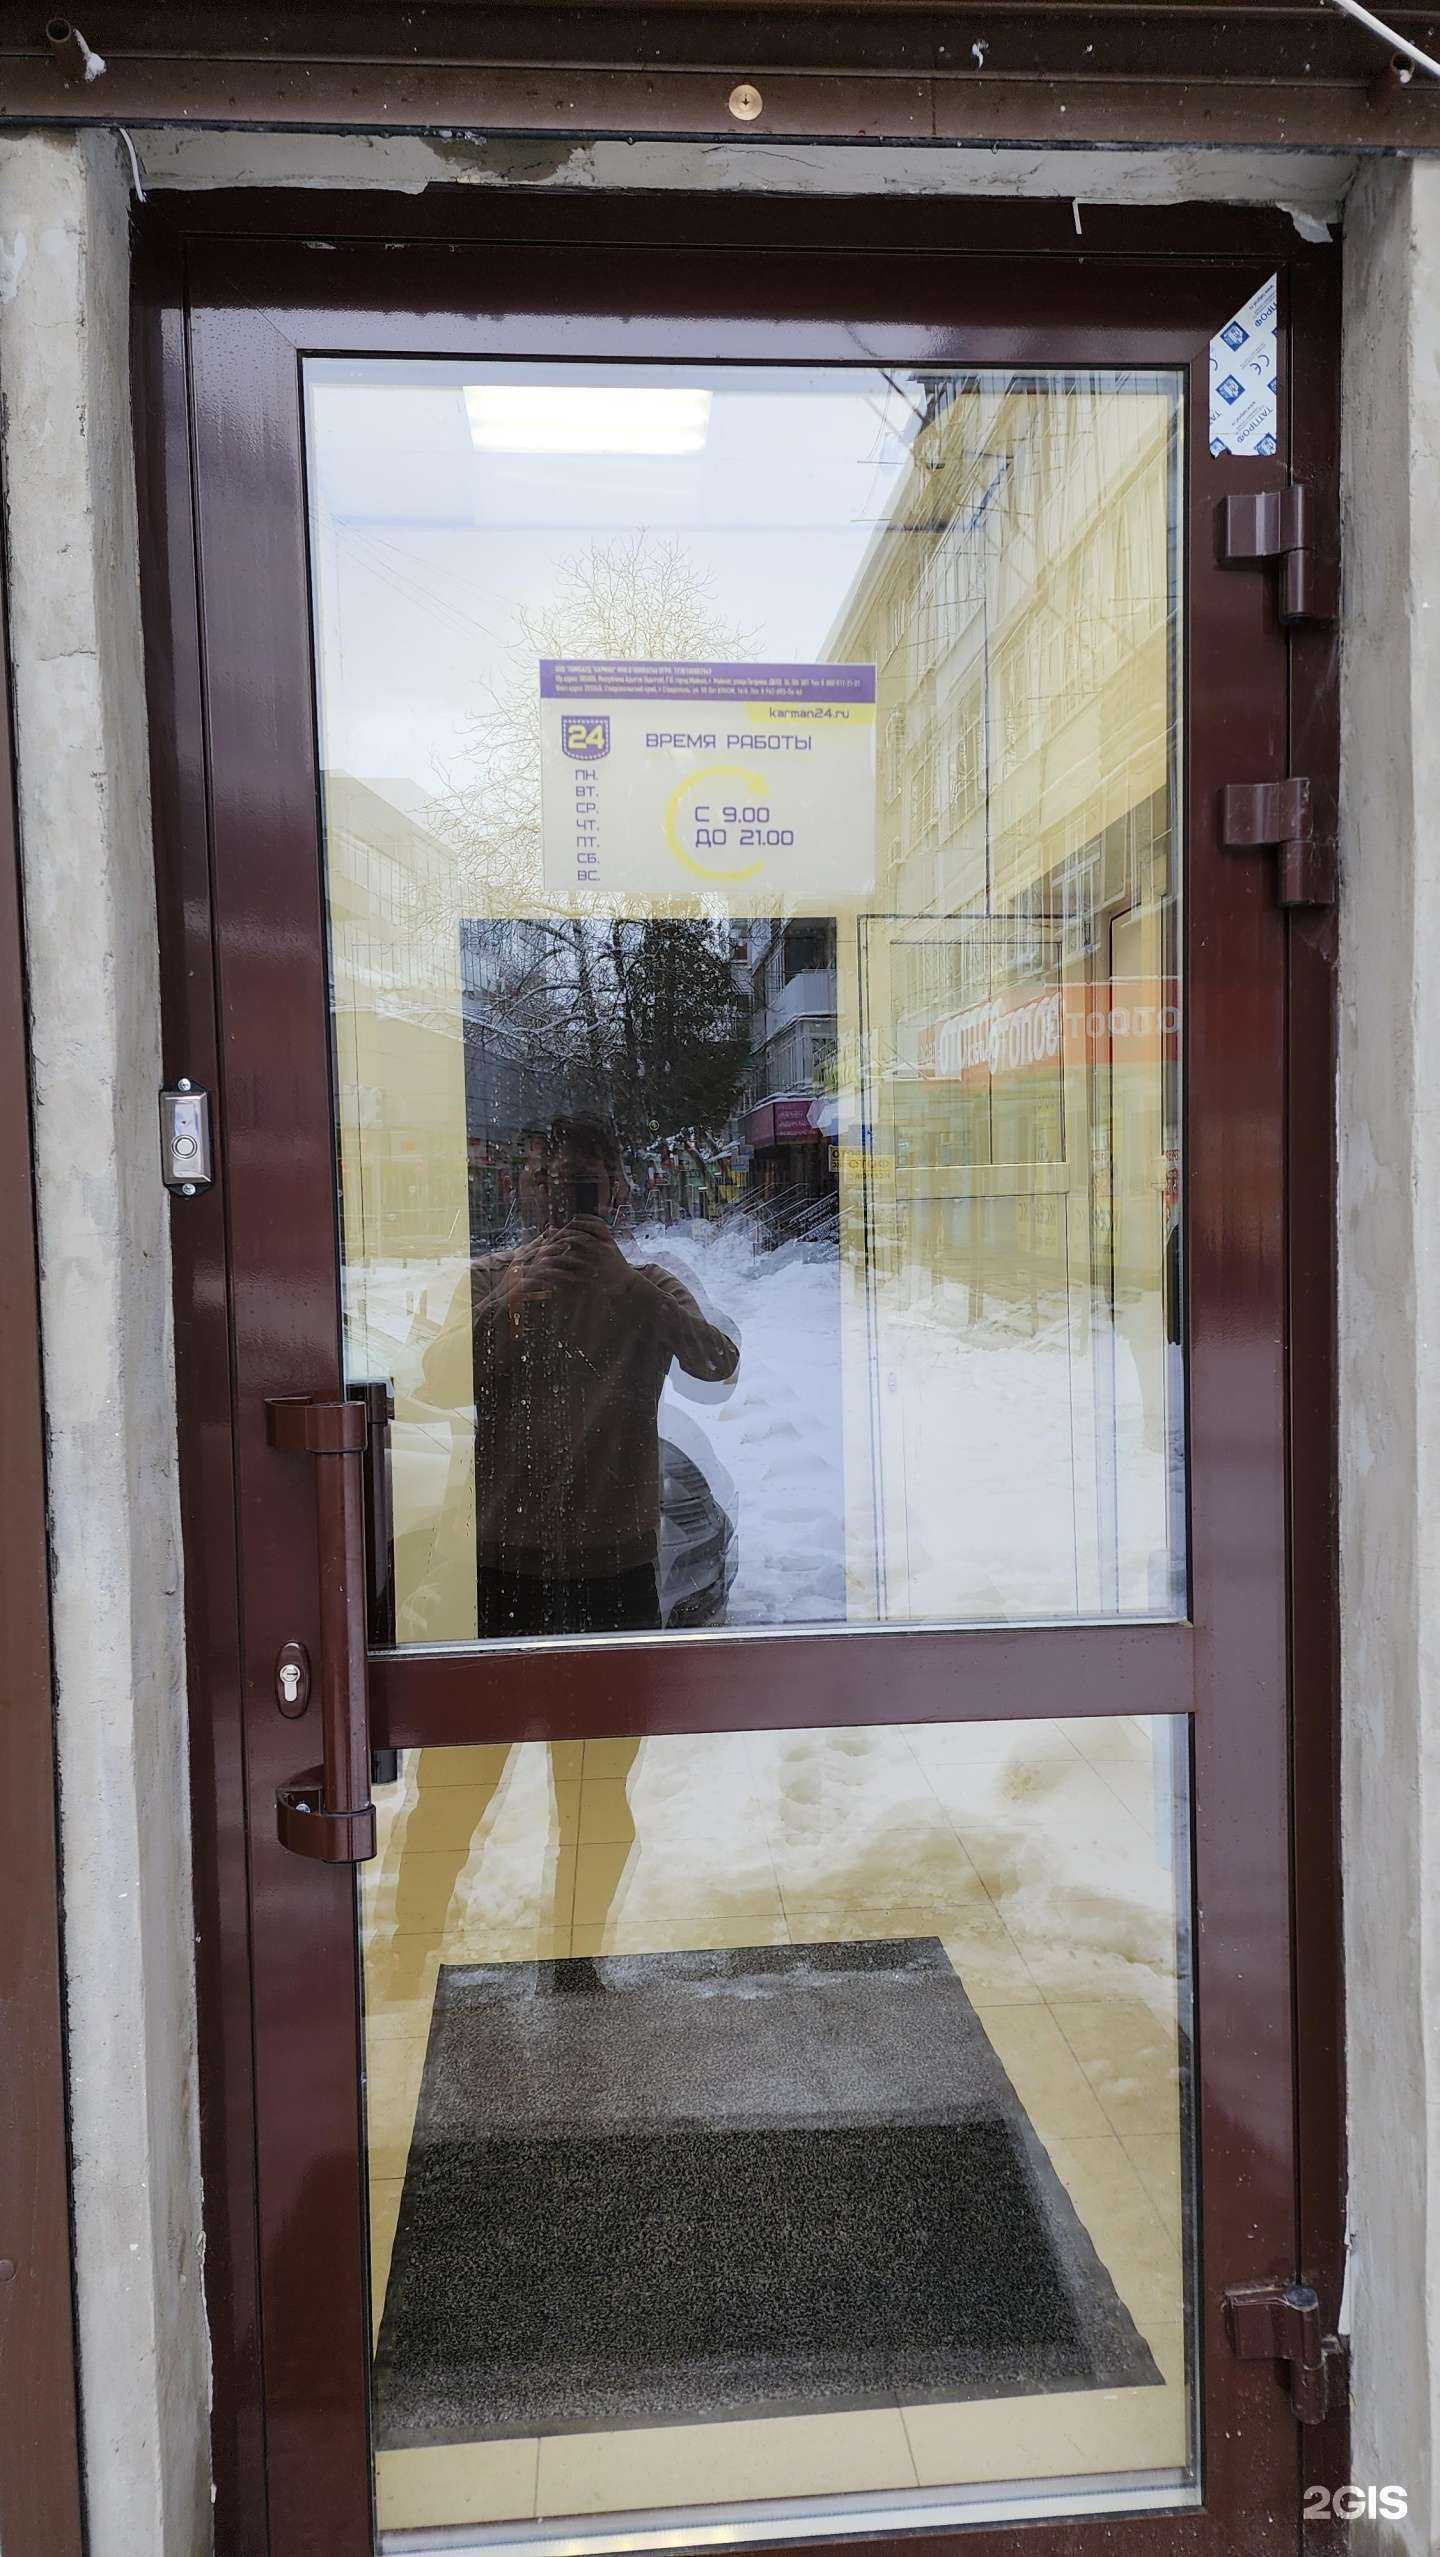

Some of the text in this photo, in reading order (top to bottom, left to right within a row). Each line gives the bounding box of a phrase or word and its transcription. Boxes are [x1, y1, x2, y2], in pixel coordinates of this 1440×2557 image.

[769, 707, 850, 719] karman24.ru
[567, 725, 605, 750] 24
[645, 733, 812, 750] ВРЕМЯ РАБОТЫ
[575, 769, 599, 781] ПН.
[575, 786, 599, 798] ВТ.
[576, 802, 599, 814] СР.
[694, 806, 770, 824] С 9.00
[576, 819, 599, 831] ЧТ.
[576, 836, 600, 848] ПТ.
[694, 829, 794, 848] ДО 21.00
[577, 852, 600, 865] СБ.
[577, 869, 601, 881] ВС.
